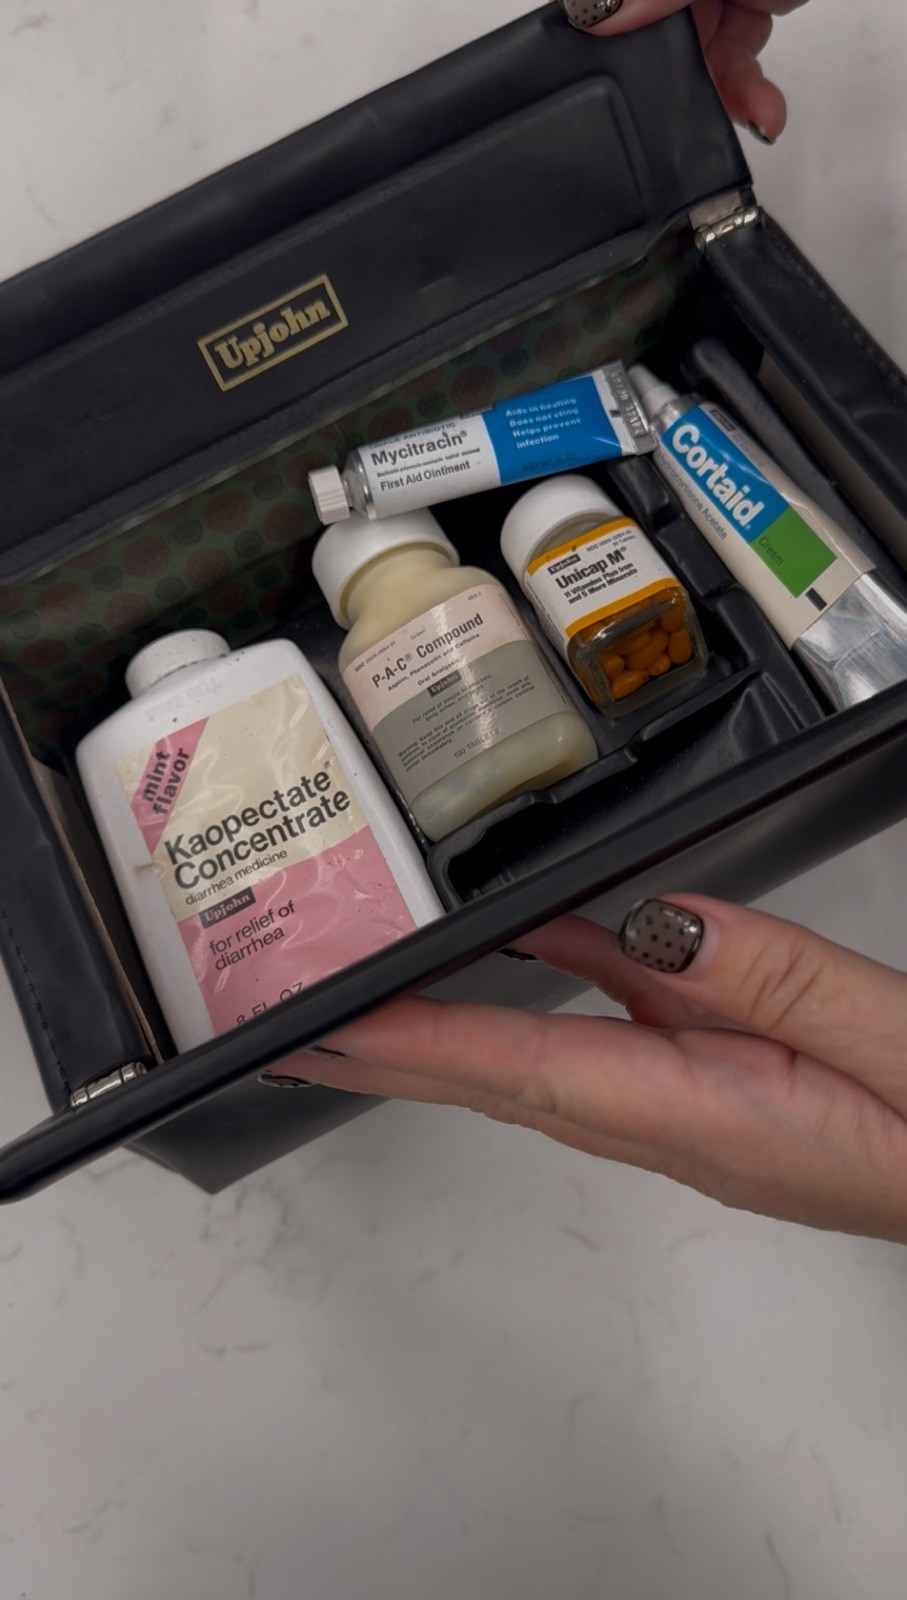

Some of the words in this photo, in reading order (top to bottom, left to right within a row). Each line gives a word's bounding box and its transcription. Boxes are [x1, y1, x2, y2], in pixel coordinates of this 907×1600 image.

[214, 300, 331, 368] Upjohn
[506, 408, 527, 417] Aids
[540, 399, 576, 411] healing
[509, 418, 534, 427] Does
[535, 414, 551, 422] not
[554, 408, 579, 418] sting
[403, 422, 456, 440] ANTIBIOTIC
[512, 428, 540, 437] Helps
[543, 419, 580, 432] prevent
[517, 435, 559, 449] infection
[380, 477, 404, 491] First
[406, 472, 423, 485] Aid
[423, 460, 470, 480] Ointment
[700, 508, 727, 540] Acetate
[759, 536, 784, 566] Cream
[555, 559, 608, 589] Unicap
[569, 594, 582, 604] and
[588, 583, 607, 594] More
[607, 569, 638, 585] Minerals
[571, 577, 602, 594] Vitamins
[602, 570, 619, 580] Plus
[618, 563, 633, 572] Iron
[416, 613, 484, 658] Compound
[388, 676, 410, 691] Aspirin,
[410, 655, 442, 676] Phenacetin
[443, 647, 454, 656] and
[455, 634, 480, 649] Caffeine
[417, 675, 430, 686] Oral
[432, 659, 461, 677] Analges
[419, 731, 433, 742] Keep
[454, 748, 466, 759] 100
[143, 750, 170, 802] mint
[152, 748, 190, 815] flavor
[173, 791, 350, 890] Concentrate
[185, 876, 234, 905] diarrhea
[234, 850, 288, 880] medicine
[204, 895, 250, 921] Upjohn
[209, 935, 232, 956] for
[235, 909, 275, 942] relief
[278, 900, 295, 918] of
[215, 927, 285, 971] diarrhea
